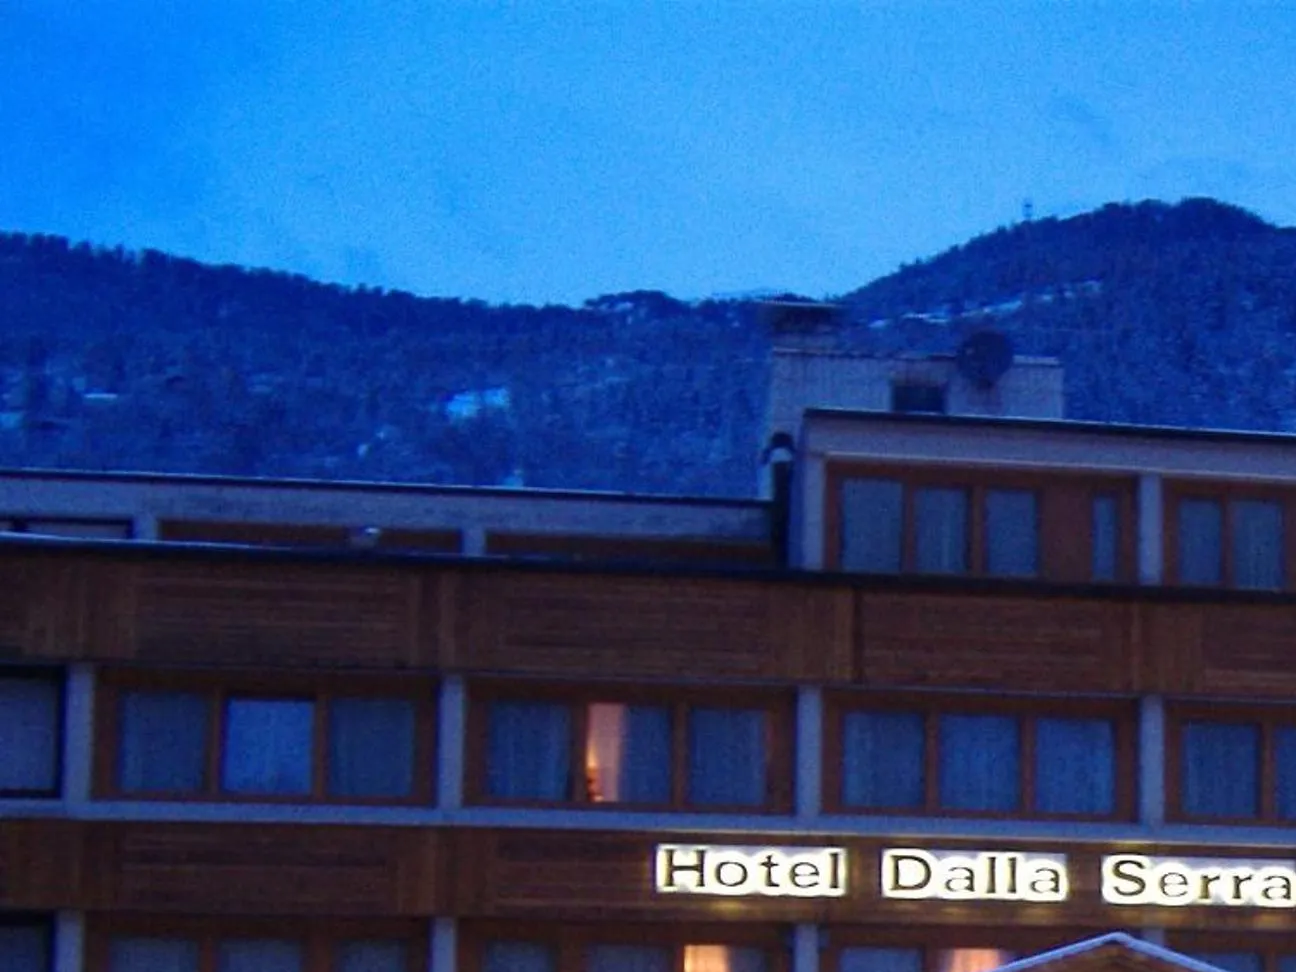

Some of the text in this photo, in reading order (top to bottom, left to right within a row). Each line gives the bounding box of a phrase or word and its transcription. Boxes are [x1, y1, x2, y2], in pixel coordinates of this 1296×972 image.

[661, 847, 1296, 902] Hotel Dalla Serra
